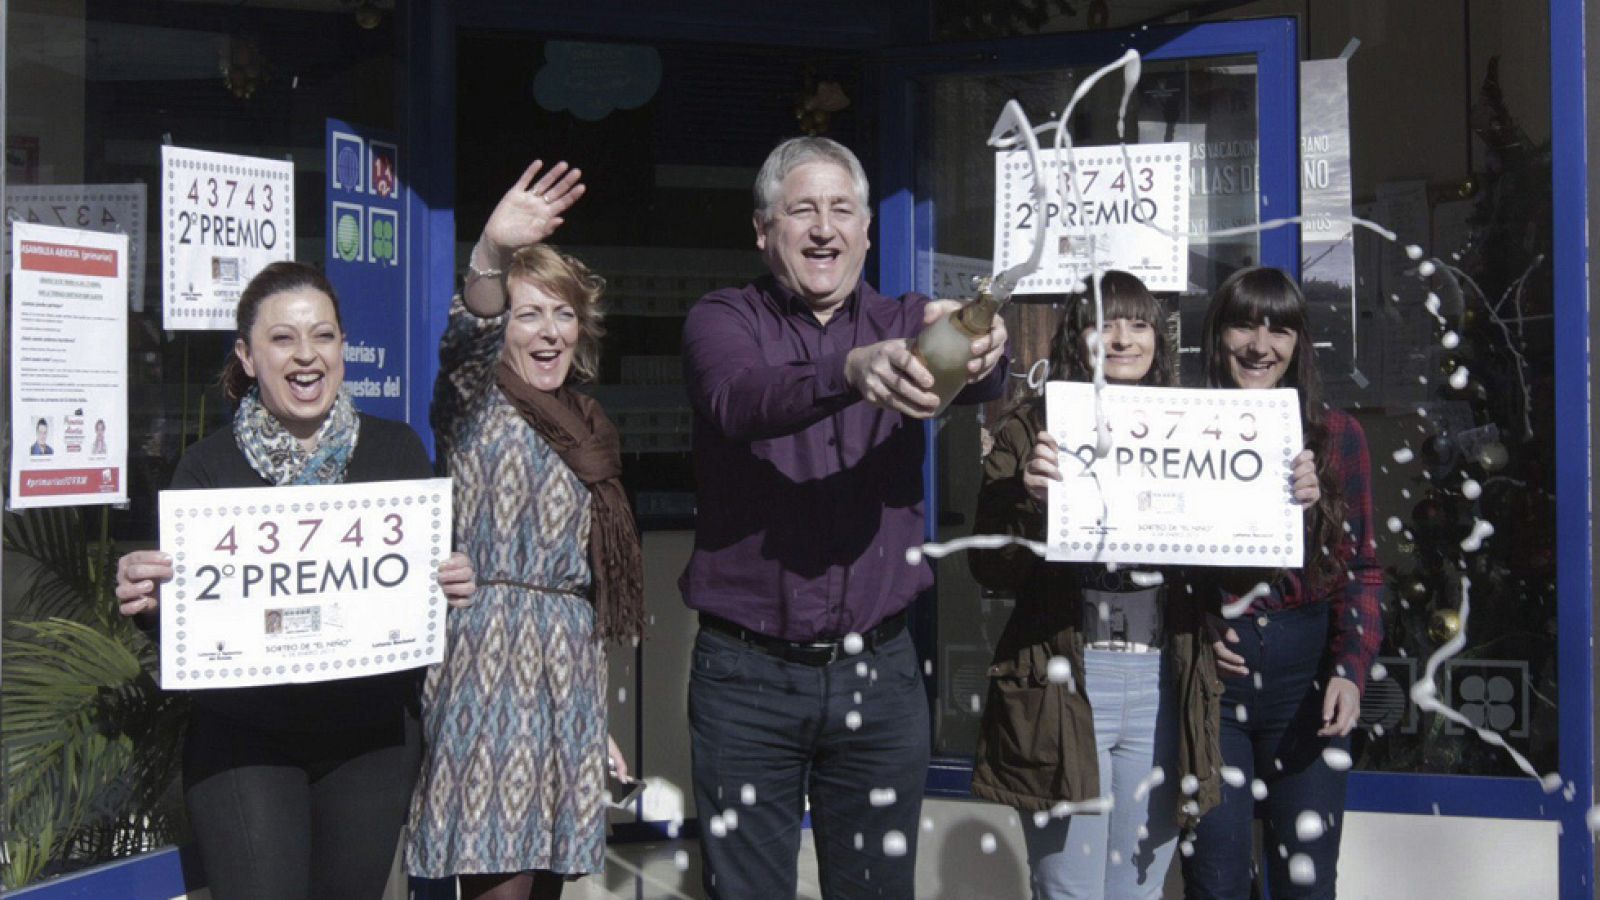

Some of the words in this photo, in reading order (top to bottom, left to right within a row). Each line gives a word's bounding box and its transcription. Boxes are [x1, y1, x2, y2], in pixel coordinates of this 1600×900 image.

[187, 177, 274, 213] 43743
[1045, 198, 1158, 228] PREMIO
[200, 213, 277, 250] PREMIO
[342, 341, 376, 363] terías
[377, 347, 386, 369] y
[383, 375, 401, 398] del
[1115, 447, 1263, 482] PREMIO
[214, 512, 405, 556] 43743
[242, 553, 409, 599] PREMIO
